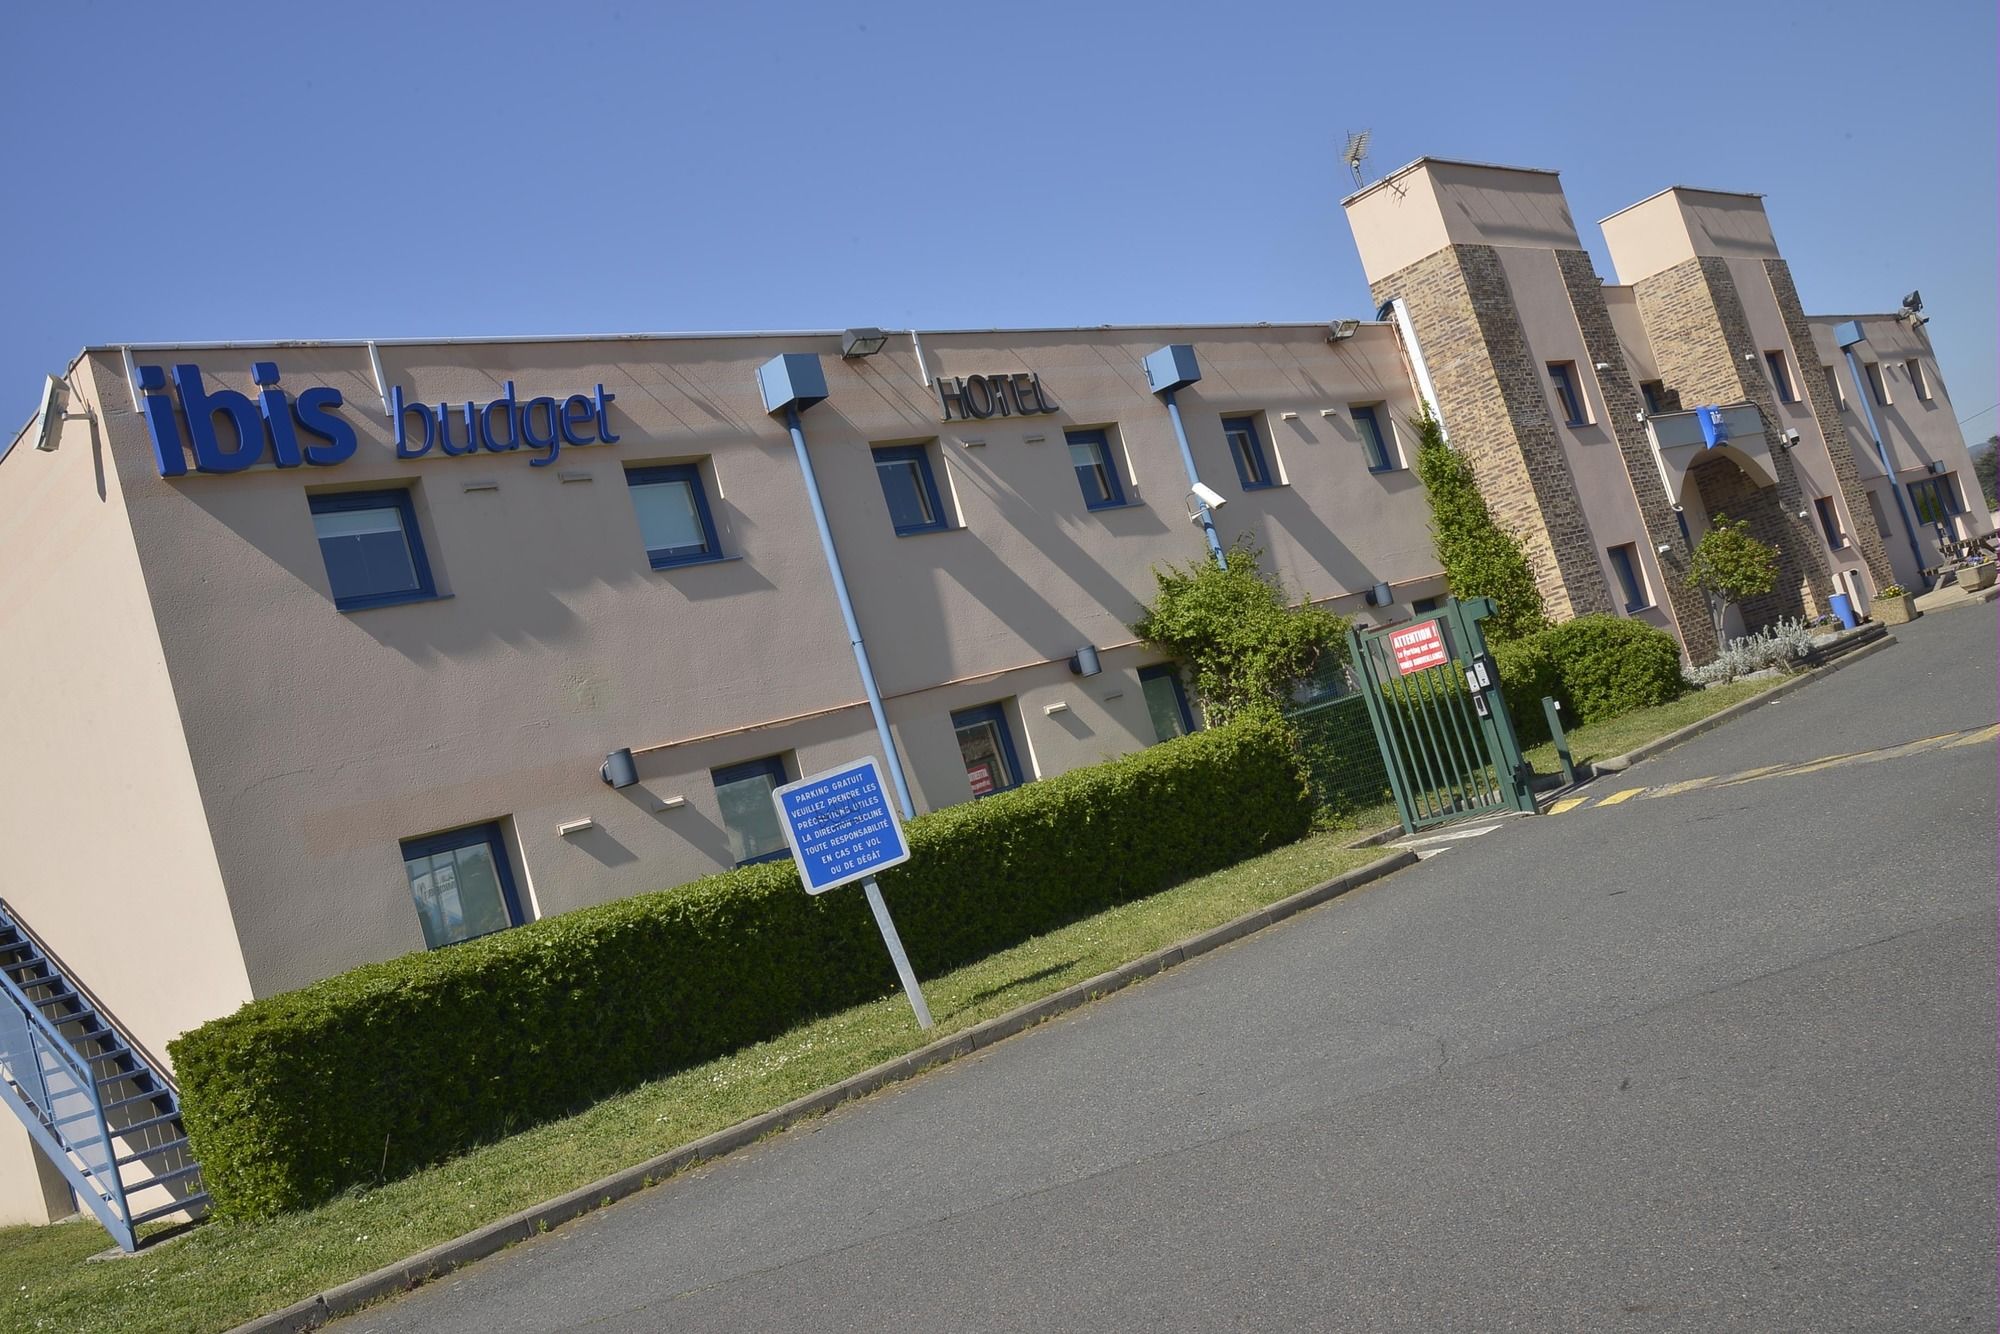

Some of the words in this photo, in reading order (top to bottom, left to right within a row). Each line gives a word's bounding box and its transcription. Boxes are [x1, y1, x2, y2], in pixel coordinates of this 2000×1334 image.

[932, 372, 1060, 421] HOTEL
[136, 362, 358, 478] ibis
[391, 380, 620, 467] budget
[791, 800, 825, 819] VEUILLEZ
[828, 788, 861, 806] PRENDRE
[863, 783, 877, 794] LES
[795, 785, 830, 803] PARKING
[832, 773, 864, 791] GRATUIT
[852, 795, 879, 812] UTILES
[801, 833, 812, 843] LA
[814, 819, 852, 838] DIRECTION
[804, 842, 828, 856] TOUTE
[830, 819, 889, 847] RESPONSABILITÉ
[821, 854, 833, 864] EN
[835, 847, 851, 859] CAS
[853, 842, 864, 852] DE
[866, 837, 881, 848] VOL
[830, 864, 842, 875] OU
[844, 859, 855, 870] DE
[857, 850, 881, 865] DÉGÂT
